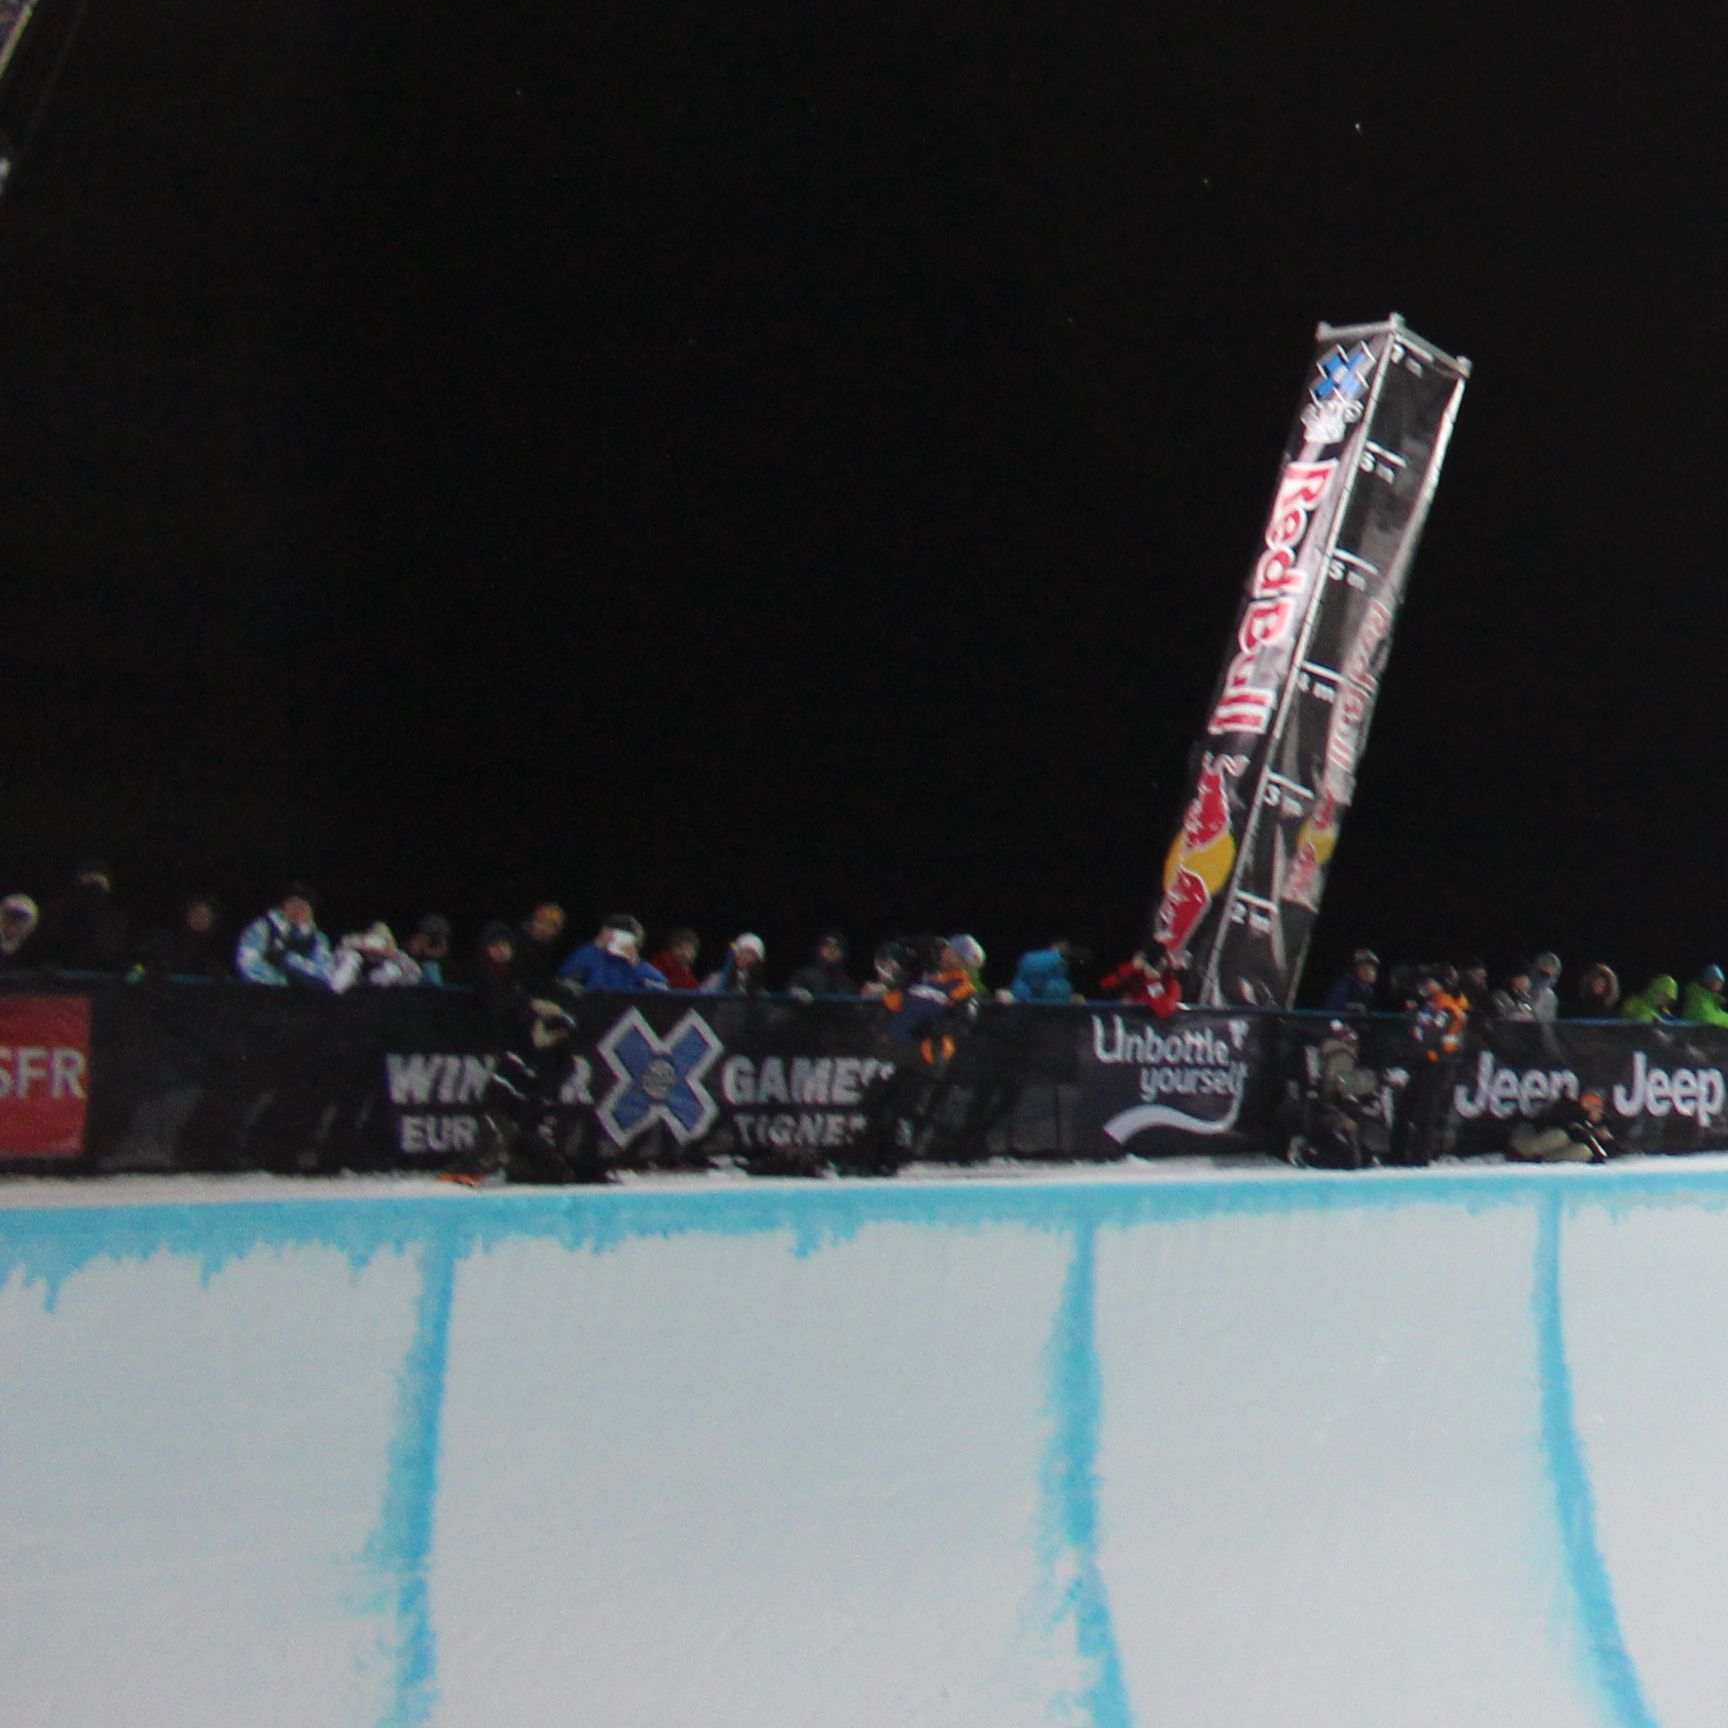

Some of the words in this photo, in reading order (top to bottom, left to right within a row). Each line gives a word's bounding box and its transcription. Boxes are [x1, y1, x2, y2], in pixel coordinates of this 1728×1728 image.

[1250, 459, 1340, 598] Red
[1092, 1013, 1231, 1065] Unbottle
[1139, 1058, 1248, 1104] yourself
[1612, 1050, 1726, 1128] Jeep
